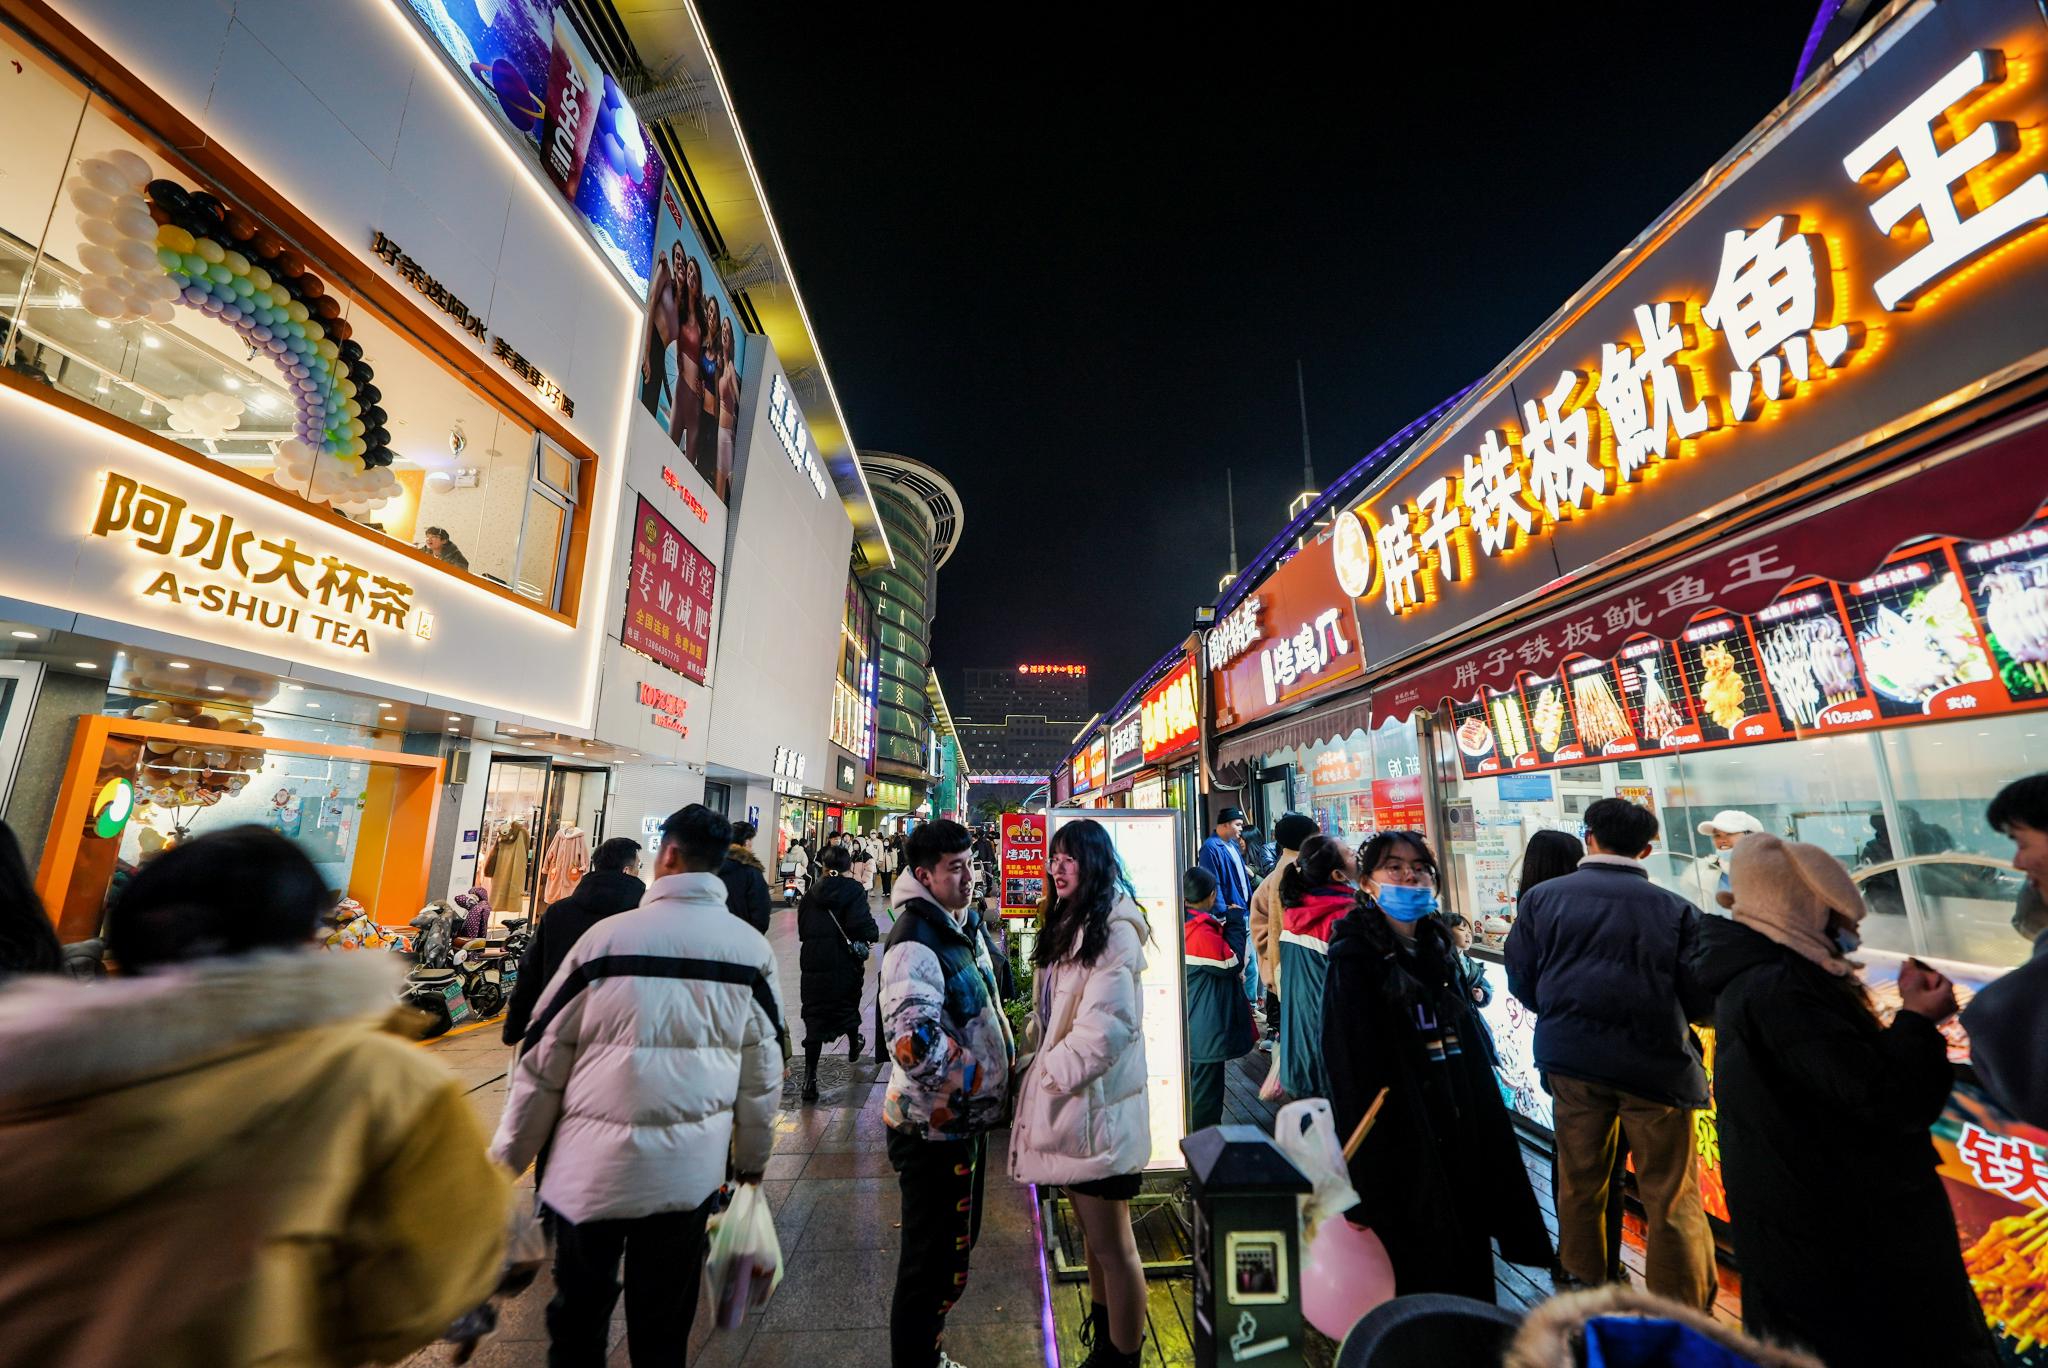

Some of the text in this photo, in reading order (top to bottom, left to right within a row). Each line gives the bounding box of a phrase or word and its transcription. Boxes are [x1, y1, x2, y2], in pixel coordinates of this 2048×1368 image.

[552, 56, 585, 171] A-SHUI
[372, 232, 488, 344] 好茶选阿水
[92, 472, 414, 629] 阿水大杯茶
[635, 562, 711, 640] 专业减肥
[661, 530, 713, 600] 御清堂
[143, 571, 300, 634] A-SHUI
[311, 614, 370, 653] TEA
[1452, 545, 1796, 690] 胖子铁板鱿鱼王
